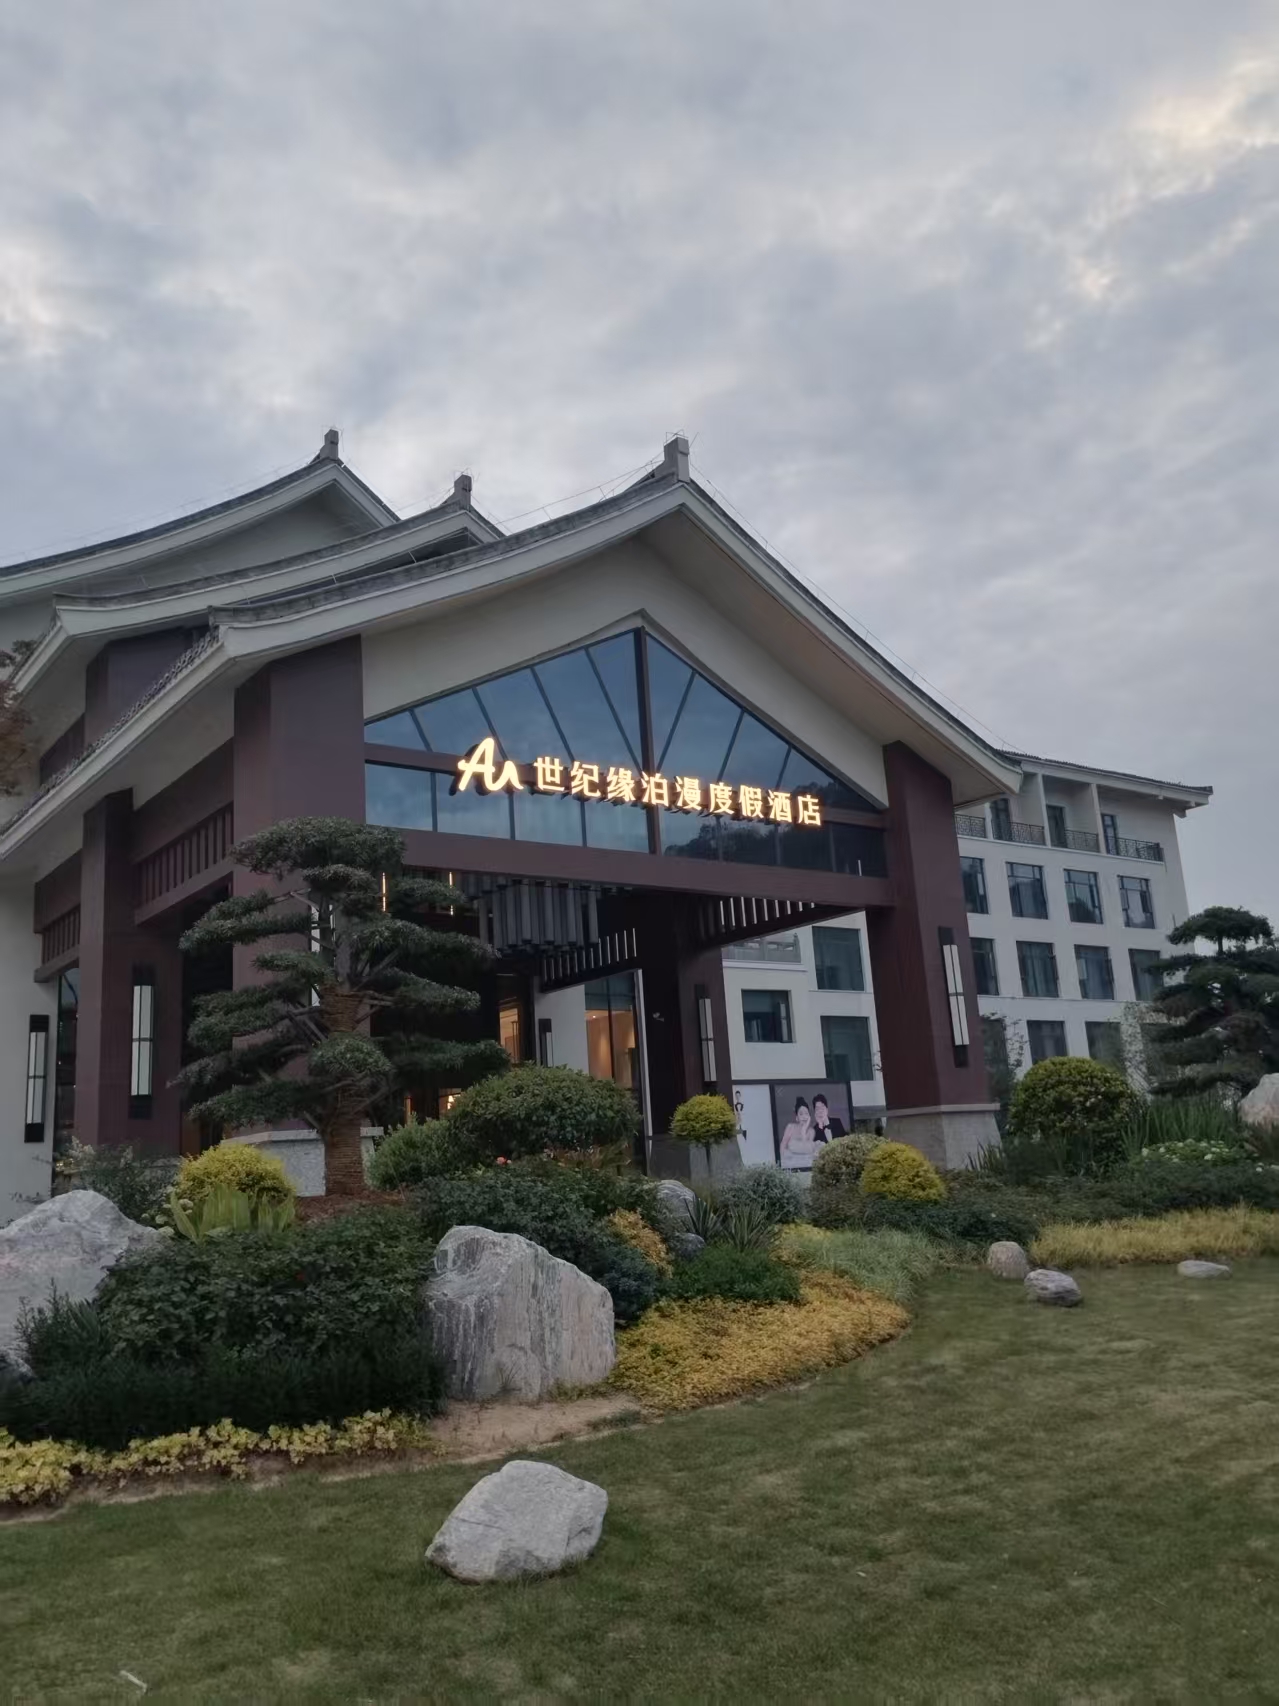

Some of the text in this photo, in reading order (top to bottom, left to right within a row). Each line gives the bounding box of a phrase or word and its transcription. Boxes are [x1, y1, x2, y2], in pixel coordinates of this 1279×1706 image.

[533, 756, 821, 826] 世纪缘泊漫度假酒店
